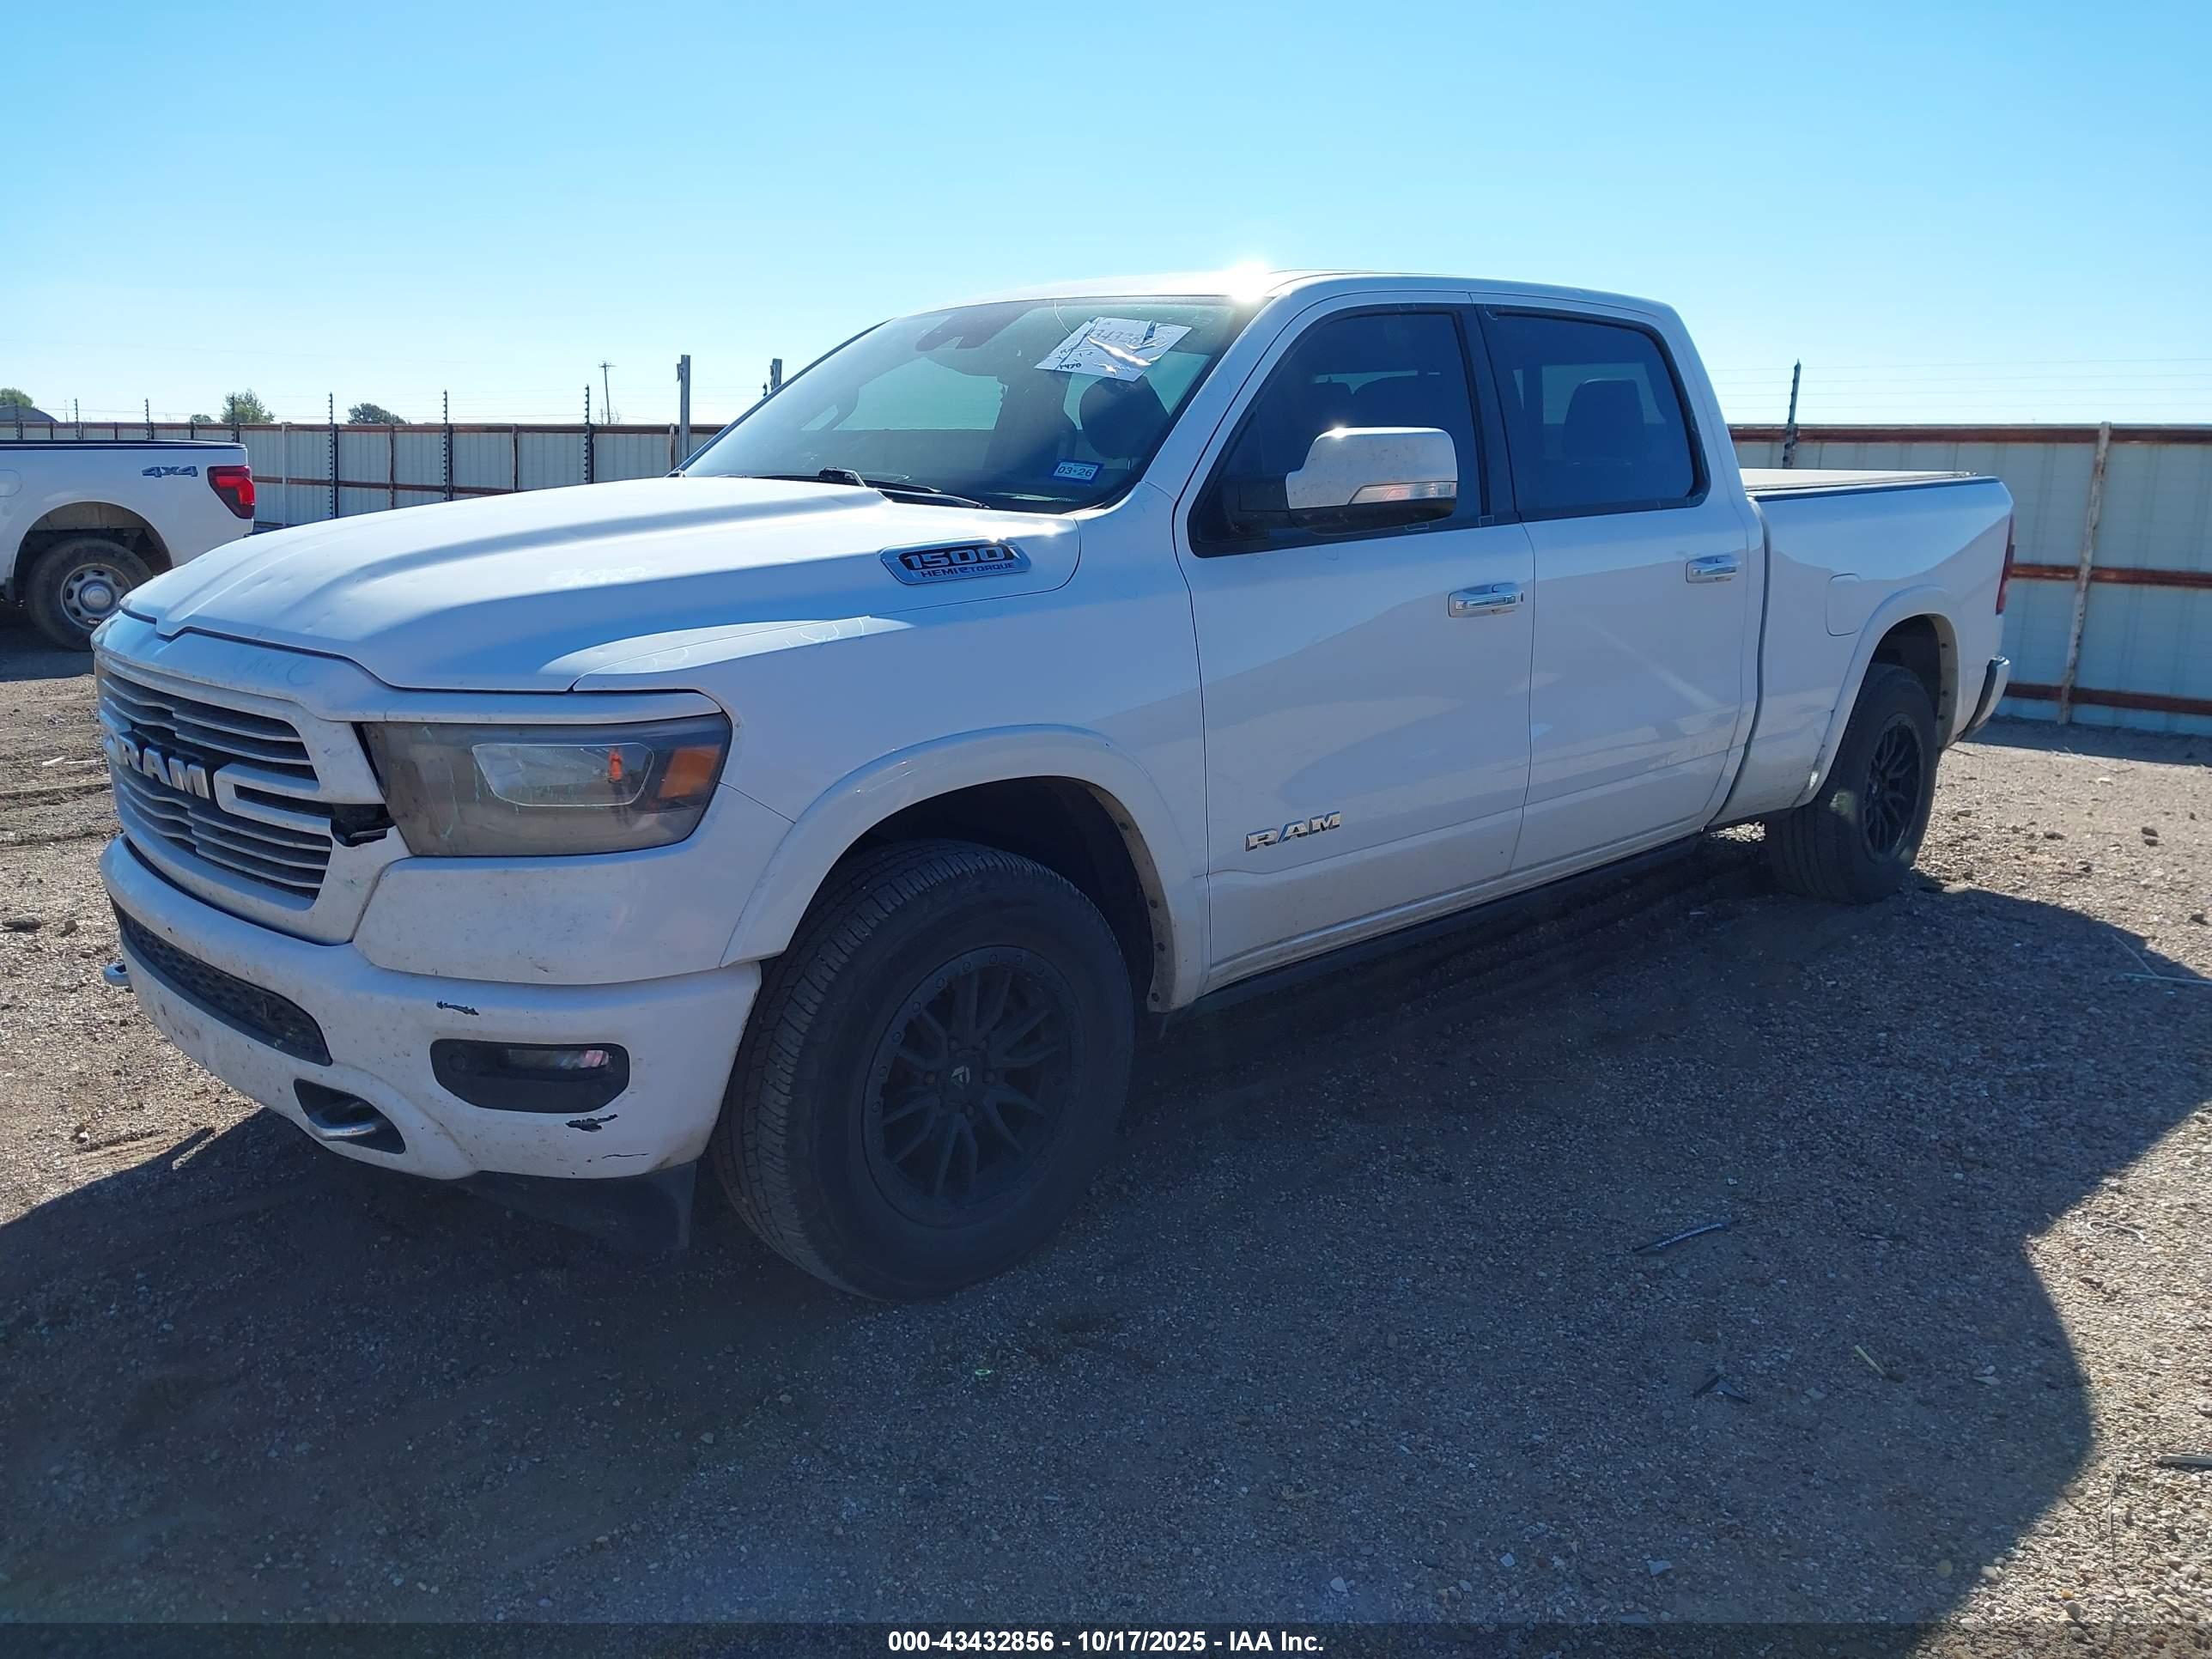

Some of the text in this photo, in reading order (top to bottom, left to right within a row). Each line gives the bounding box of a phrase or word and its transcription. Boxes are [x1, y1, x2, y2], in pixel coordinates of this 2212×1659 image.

[905, 546, 1006, 568] 1500
[921, 568, 957, 578] HEMI
[117, 730, 210, 799] RAM
[1245, 811, 1341, 852] RAM
